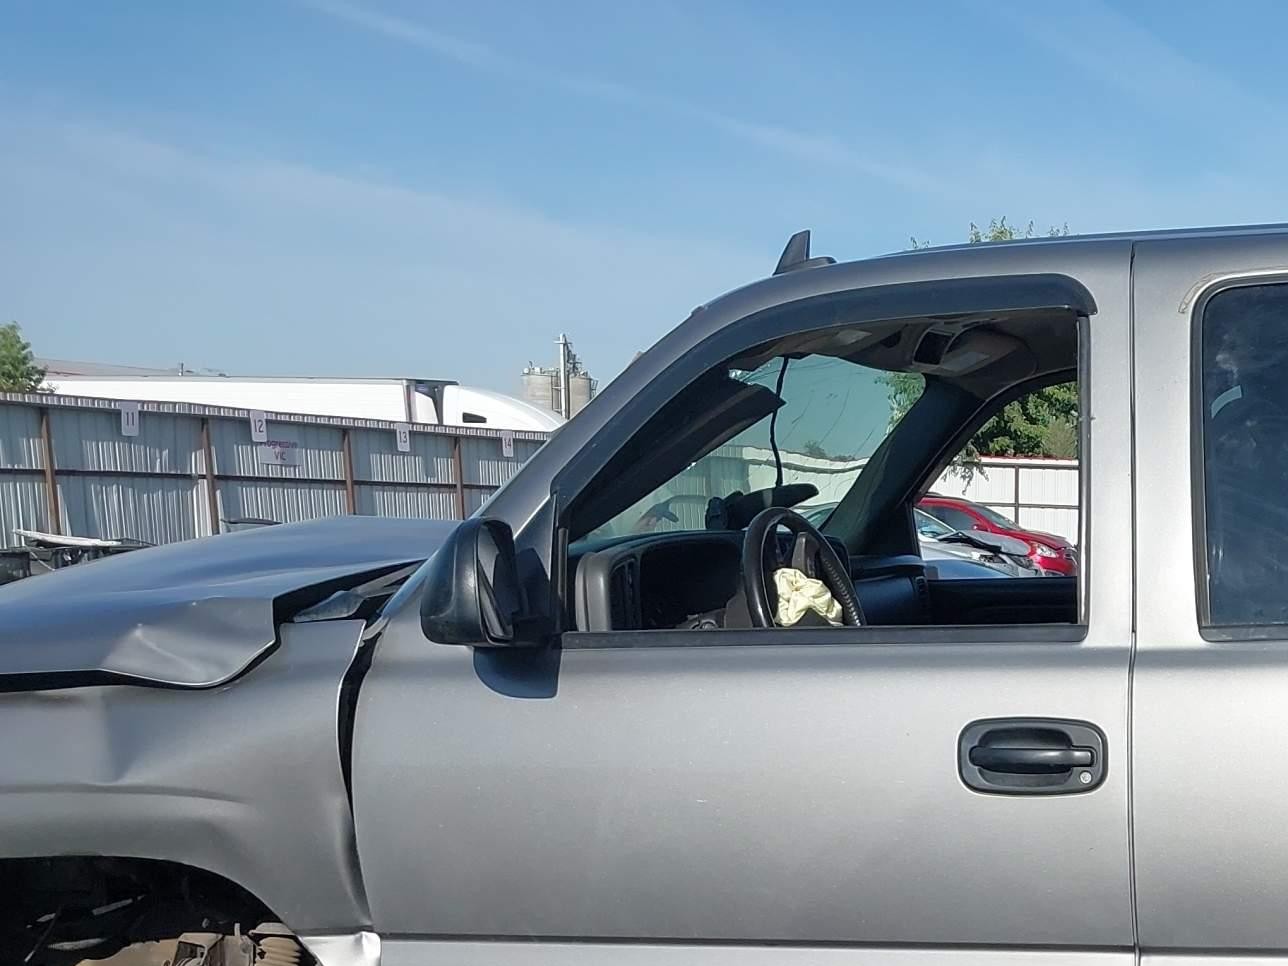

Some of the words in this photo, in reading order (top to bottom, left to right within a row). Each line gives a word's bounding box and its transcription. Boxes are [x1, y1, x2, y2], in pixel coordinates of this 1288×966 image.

[126, 411, 135, 427] 11
[254, 419, 264, 433] 12
[399, 430, 408, 443] 13
[504, 437, 512, 449] 14
